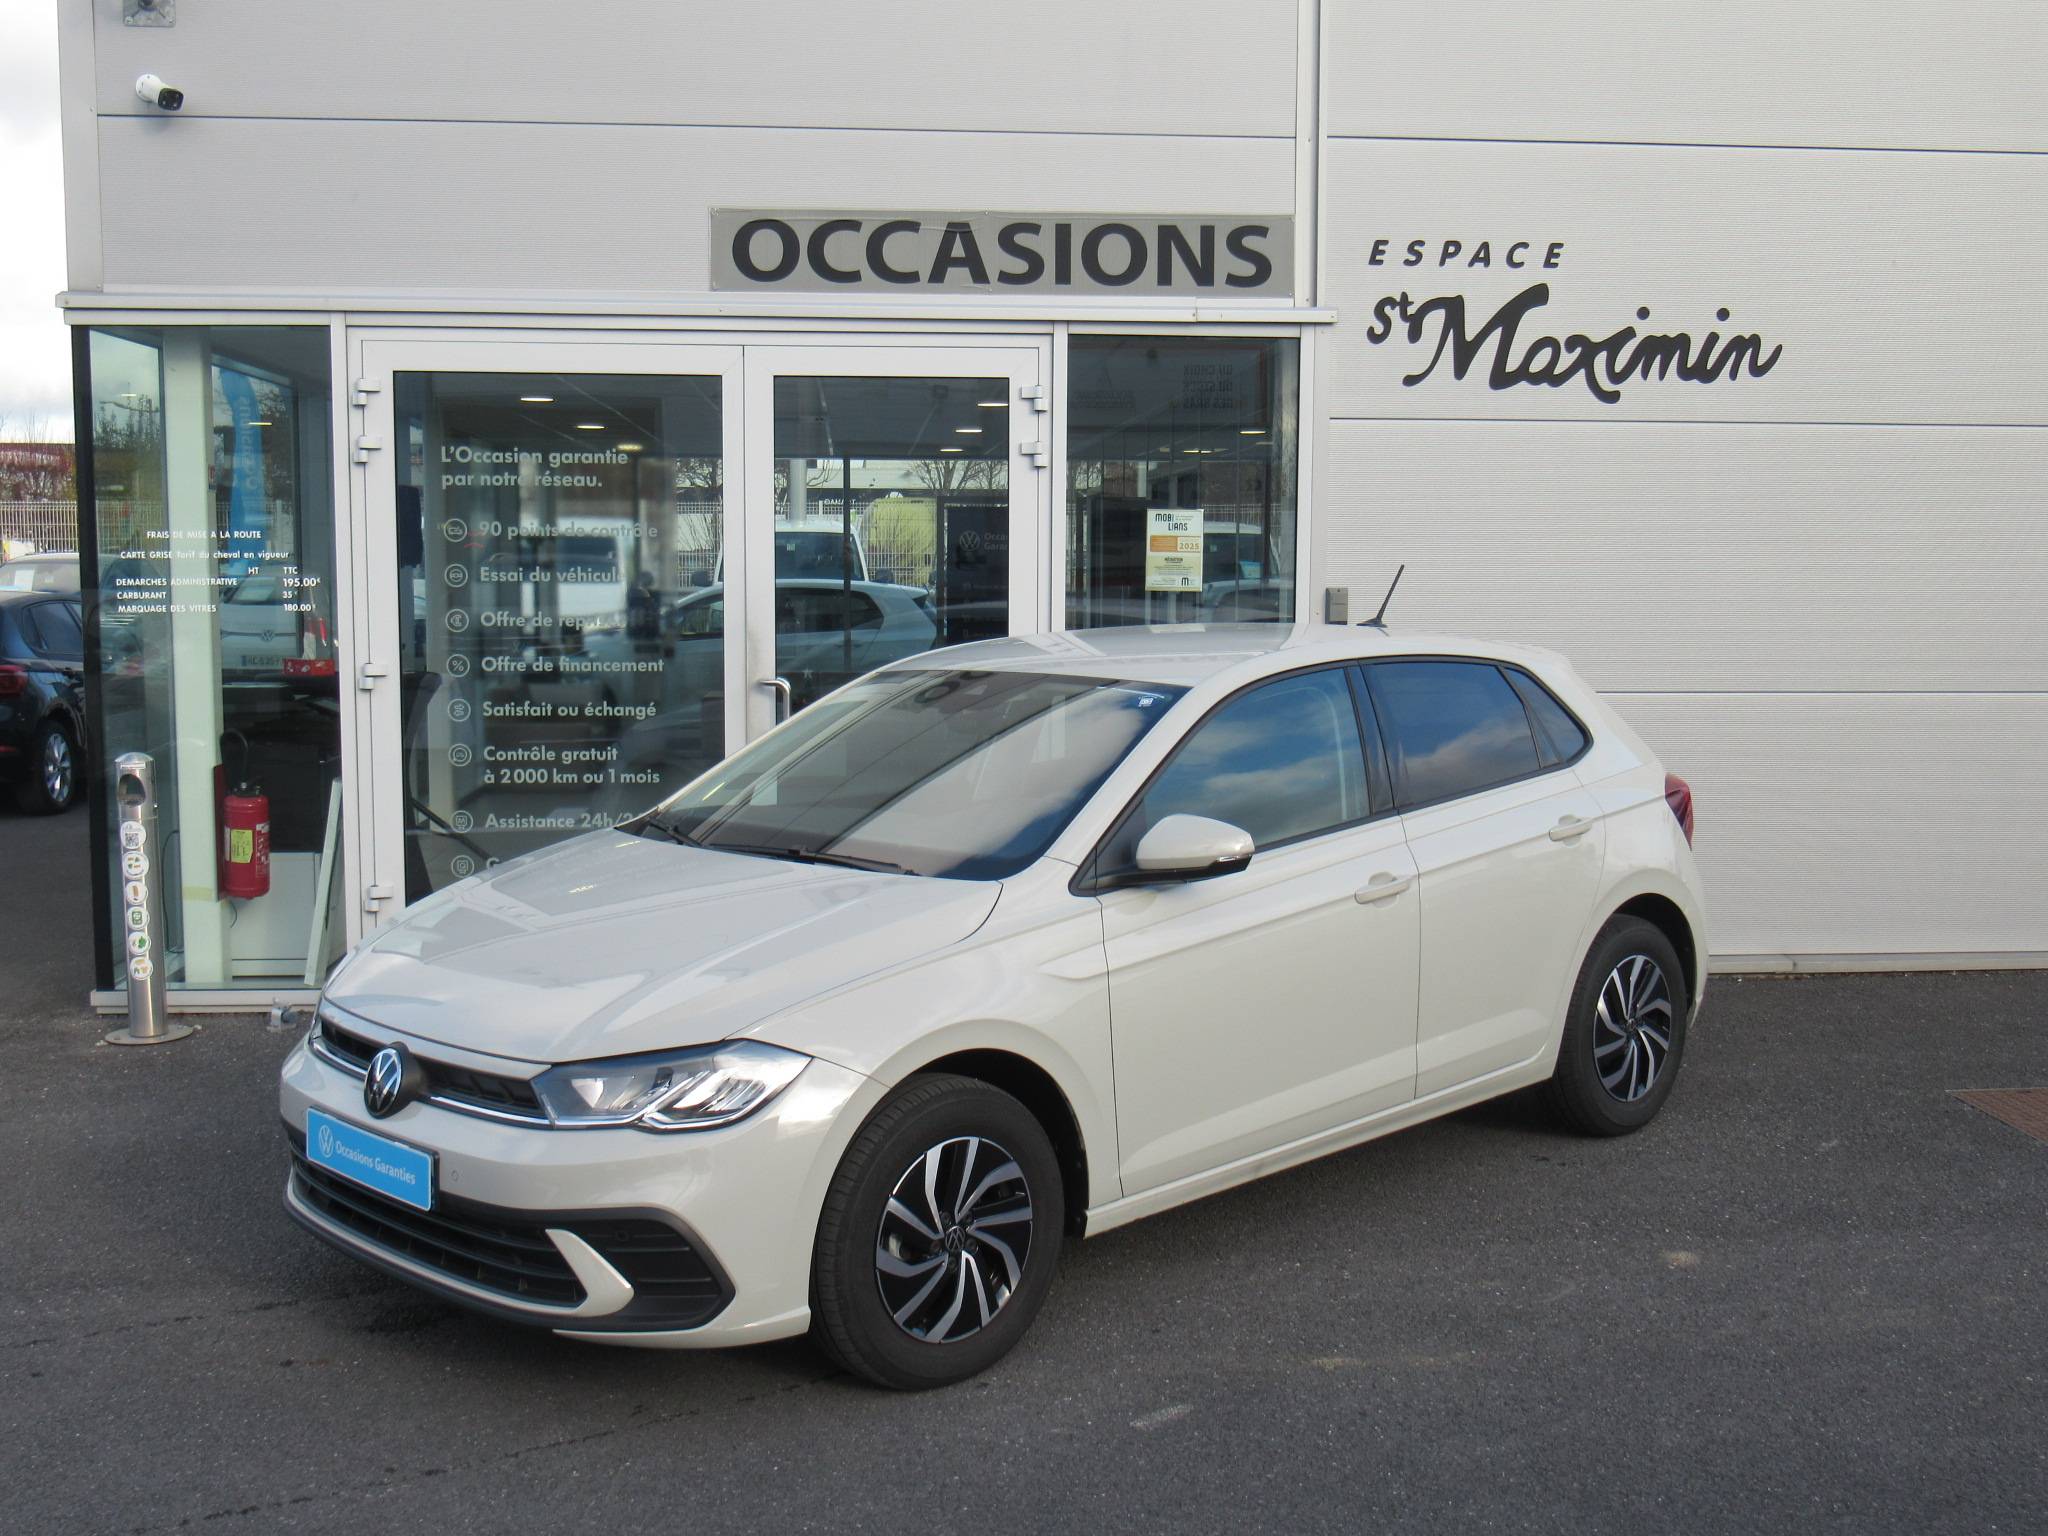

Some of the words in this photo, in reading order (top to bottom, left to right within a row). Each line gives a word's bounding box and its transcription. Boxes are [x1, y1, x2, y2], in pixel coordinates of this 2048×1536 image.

[731, 218, 1273, 288] OCCASIONS
[1368, 239, 1565, 269] ESPACE
[1402, 282, 1783, 404] Maximin
[549, 447, 628, 468] garantie
[441, 474, 474, 490] par
[480, 472, 530, 487] notre
[534, 471, 603, 487] réseau.
[147, 531, 170, 539] FRAIS
[234, 531, 261, 539] ROUTE
[479, 522, 502, 537] 90
[507, 522, 559, 540] points
[213, 551, 240, 559] cheval
[258, 552, 289, 561] vigueur
[116, 578, 167, 586] DEMARCHES
[170, 578, 238, 586] ADMINISTRATIVE
[480, 567, 523, 582] Essai
[529, 567, 551, 582] du
[480, 612, 526, 627] Offre
[532, 612, 553, 627] de
[481, 656, 527, 672] Offre
[532, 656, 554, 672] de
[559, 656, 664, 672] financement
[482, 701, 553, 717] Satisfait
[558, 705, 579, 717] ou
[584, 702, 657, 720] échangé
[483, 746, 556, 762] Contrôle
[561, 747, 618, 764] gratuit
[484, 769, 495, 784] à
[553, 769, 578, 784] km
[583, 772, 604, 784] ou
[608, 769, 615, 783] 1
[620, 769, 661, 784] mois
[485, 814, 575, 829] Assistance
[336, 1141, 373, 1168] Occasions
[375, 1158, 416, 1185] Garanties
